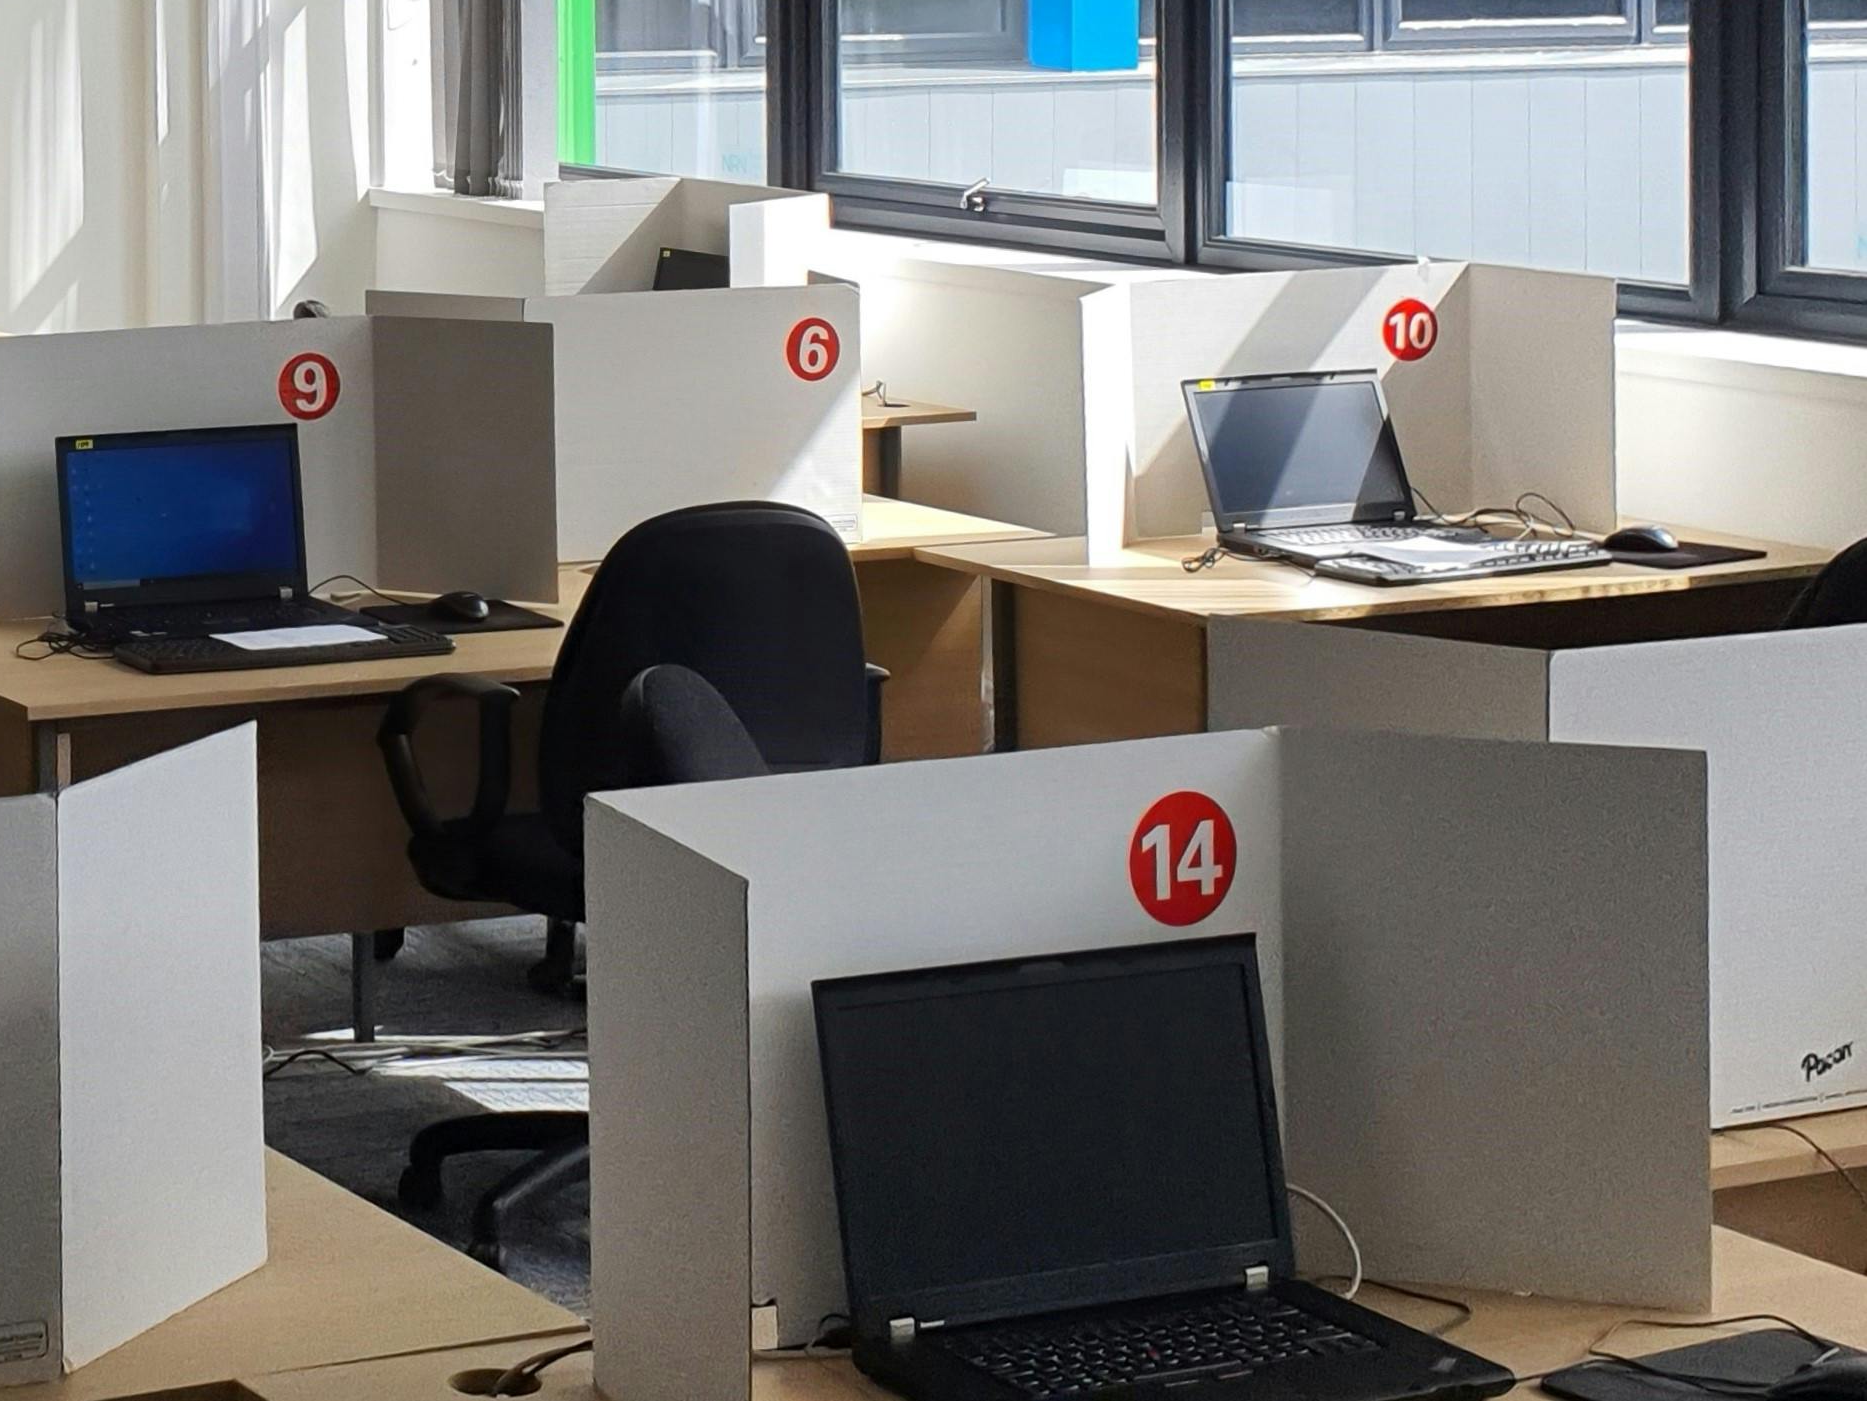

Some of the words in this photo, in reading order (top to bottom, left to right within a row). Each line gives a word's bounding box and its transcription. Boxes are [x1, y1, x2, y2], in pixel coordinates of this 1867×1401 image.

[799, 326, 828, 373] 6
[1388, 312, 1432, 349] 10
[293, 361, 327, 412] 9
[1140, 820, 1223, 900] 14
[1800, 1041, 1854, 1083] Pacon
